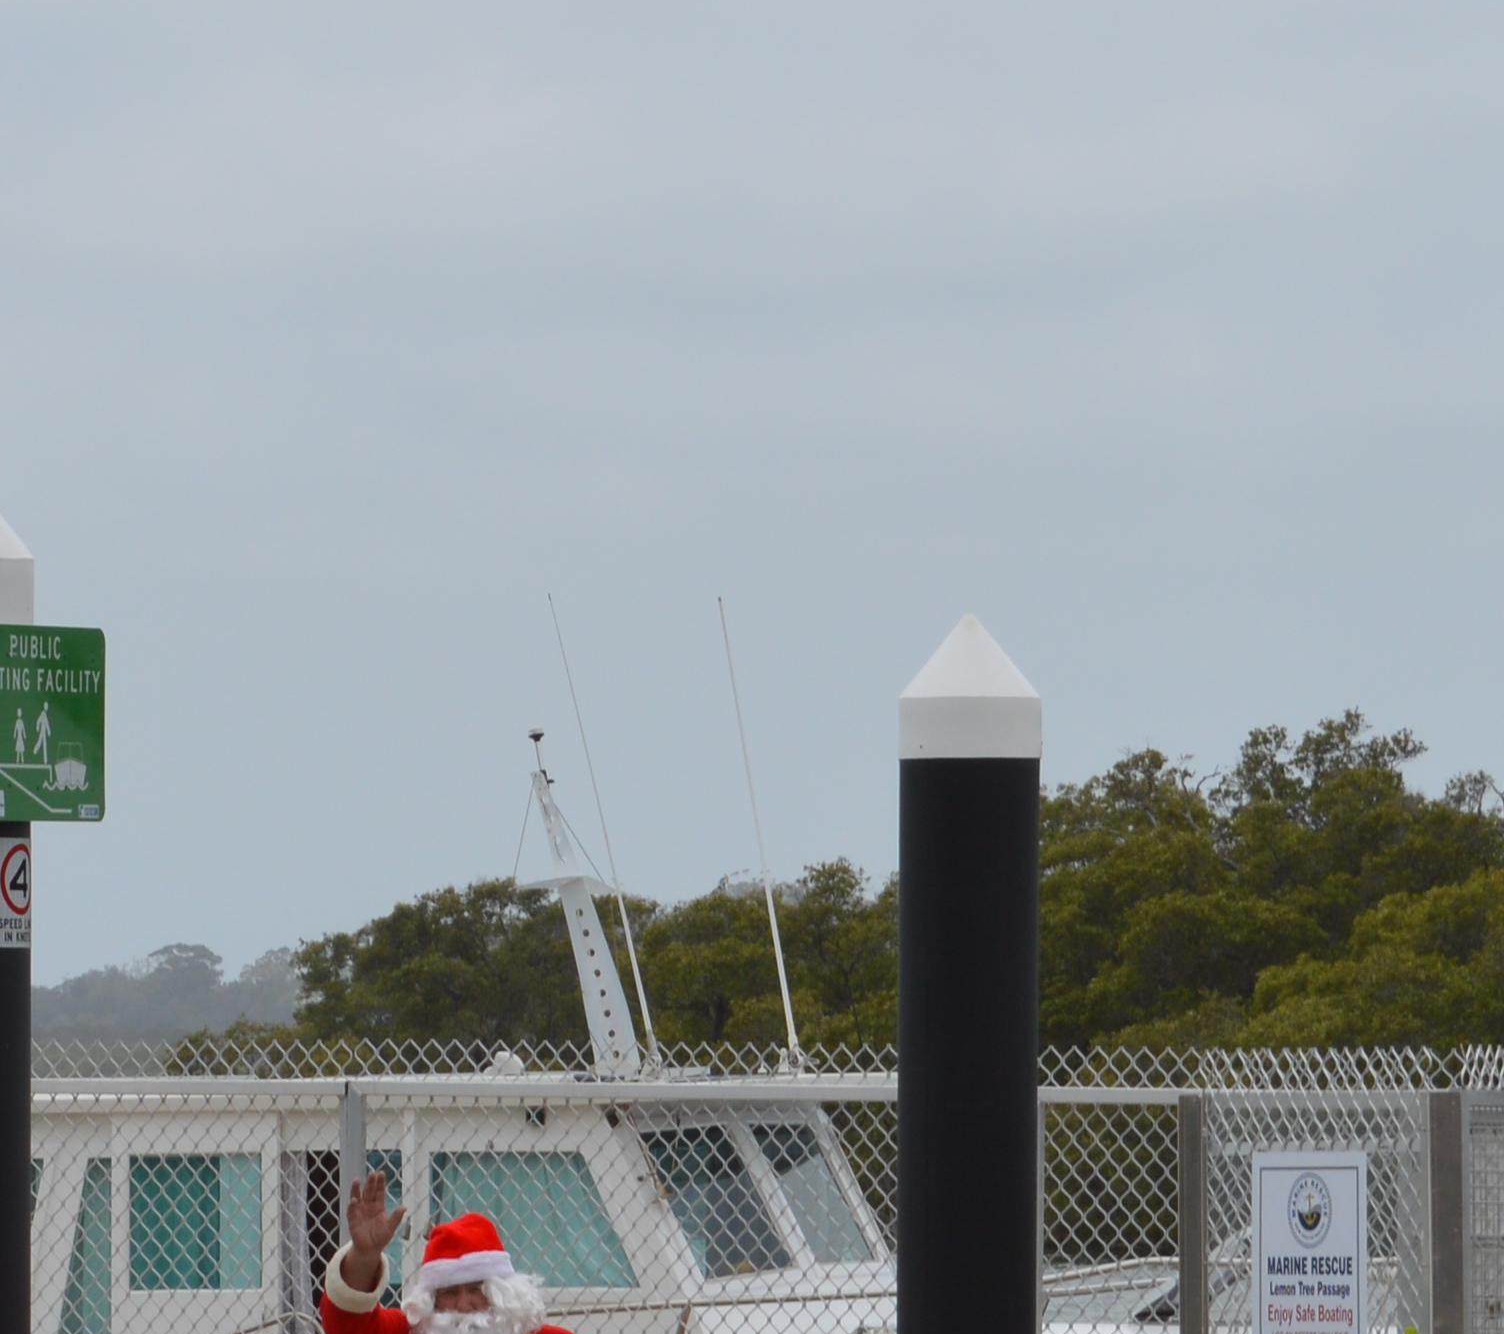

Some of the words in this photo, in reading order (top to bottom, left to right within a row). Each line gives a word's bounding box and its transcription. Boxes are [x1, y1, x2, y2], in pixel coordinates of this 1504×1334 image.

[9, 634, 61, 660] PUBLIC
[37, 669, 101, 693] FACILITY
[9, 858, 28, 898] 4
[4, 931, 13, 942] IN
[1267, 1256, 1308, 1275] MARINE
[1311, 1256, 1353, 1275] RESCUE
[1269, 1281, 1296, 1296] Lemon
[1298, 1281, 1315, 1296] Tree
[1317, 1281, 1350, 1299] Passage
[1268, 1304, 1293, 1326] Enjoy
[1295, 1303, 1315, 1322] Safe
[1318, 1304, 1353, 1327] Boating
